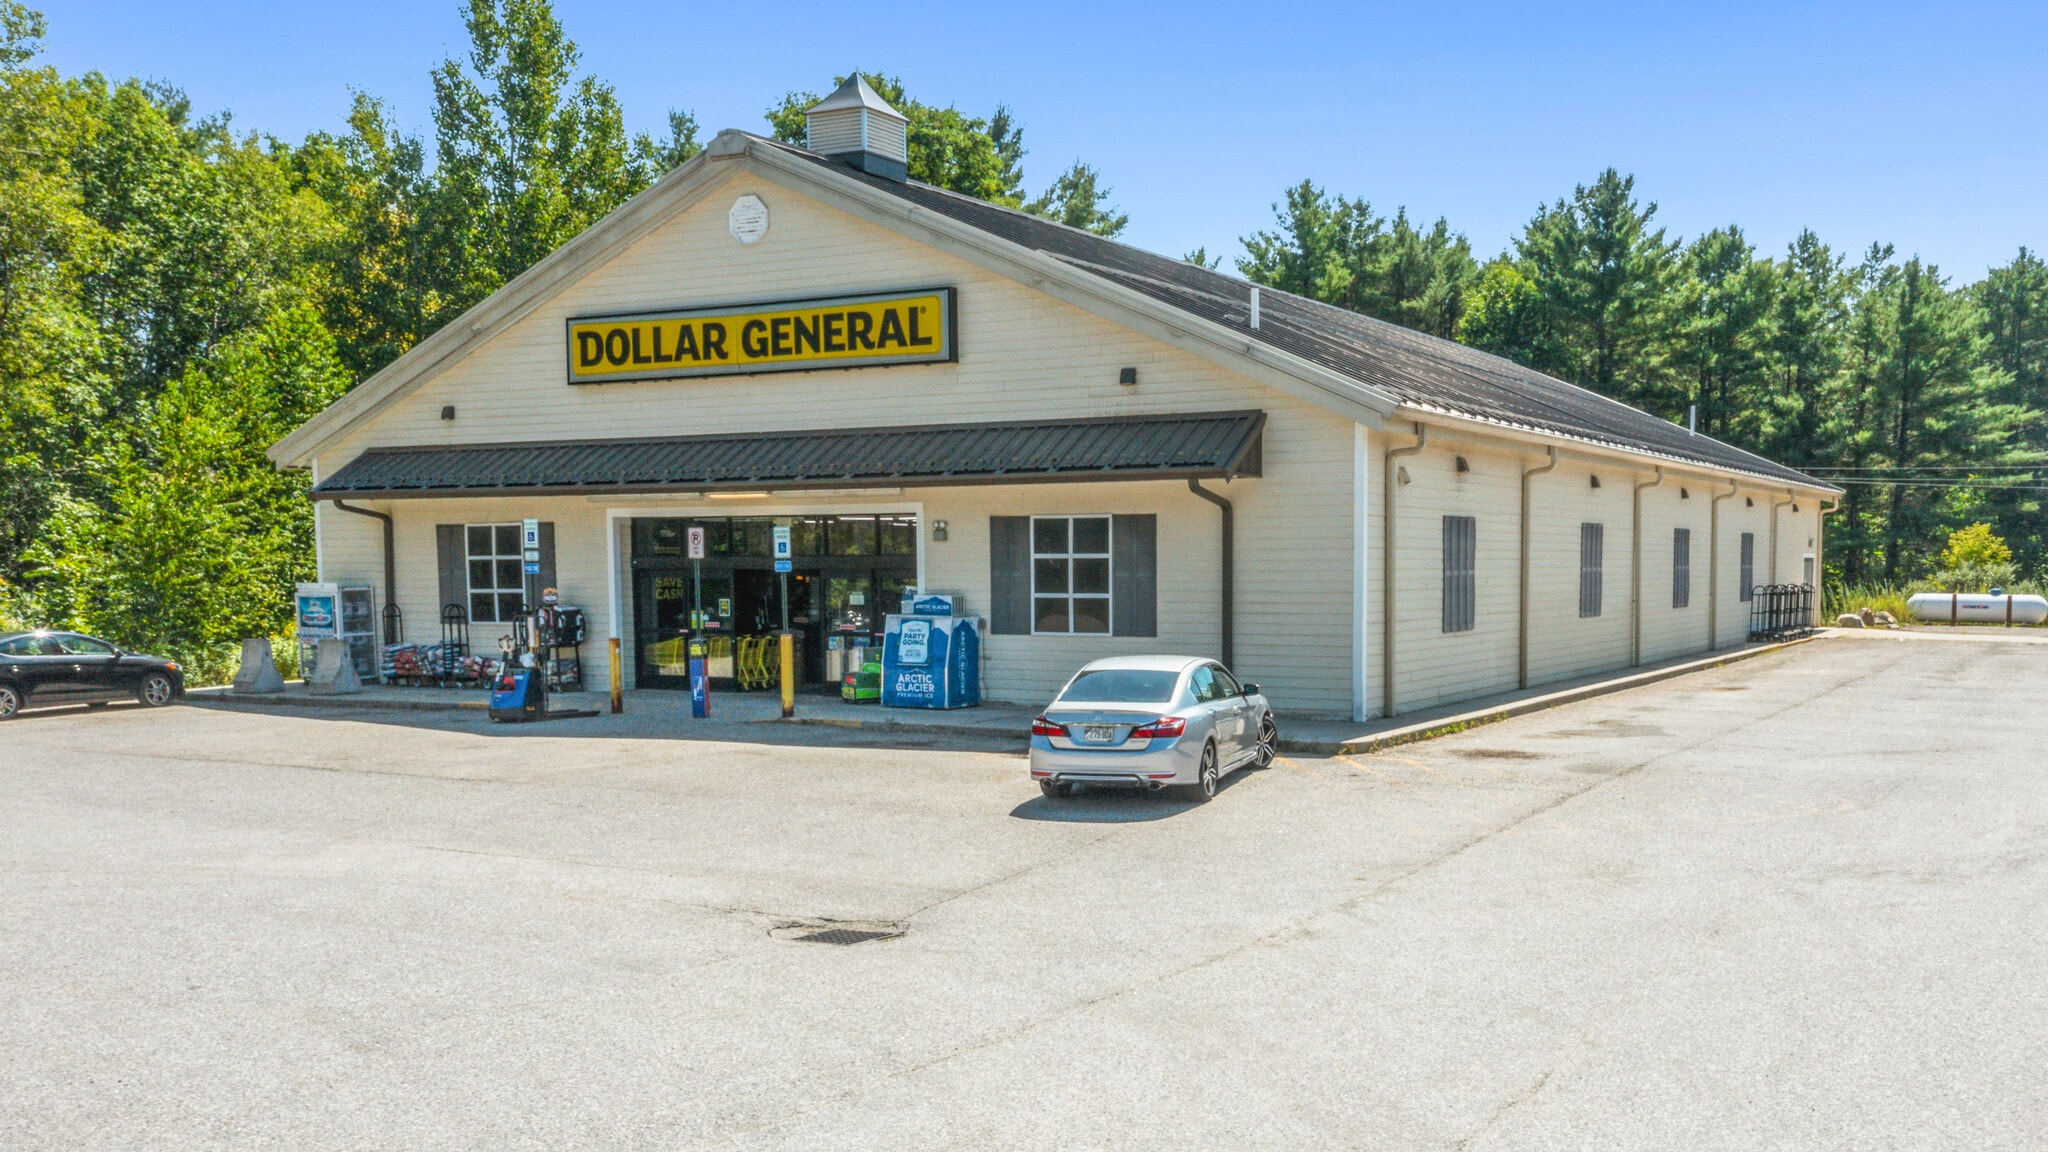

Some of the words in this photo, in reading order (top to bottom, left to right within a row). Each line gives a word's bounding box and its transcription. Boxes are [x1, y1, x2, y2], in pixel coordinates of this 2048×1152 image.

[577, 322, 728, 367] DOLLAR
[741, 306, 932, 358] GENERAL
[655, 577, 683, 587] SAVE
[655, 588, 684, 600] CASH
[898, 674, 932, 683] ARCTIC
[896, 683, 934, 692] GLACIER
